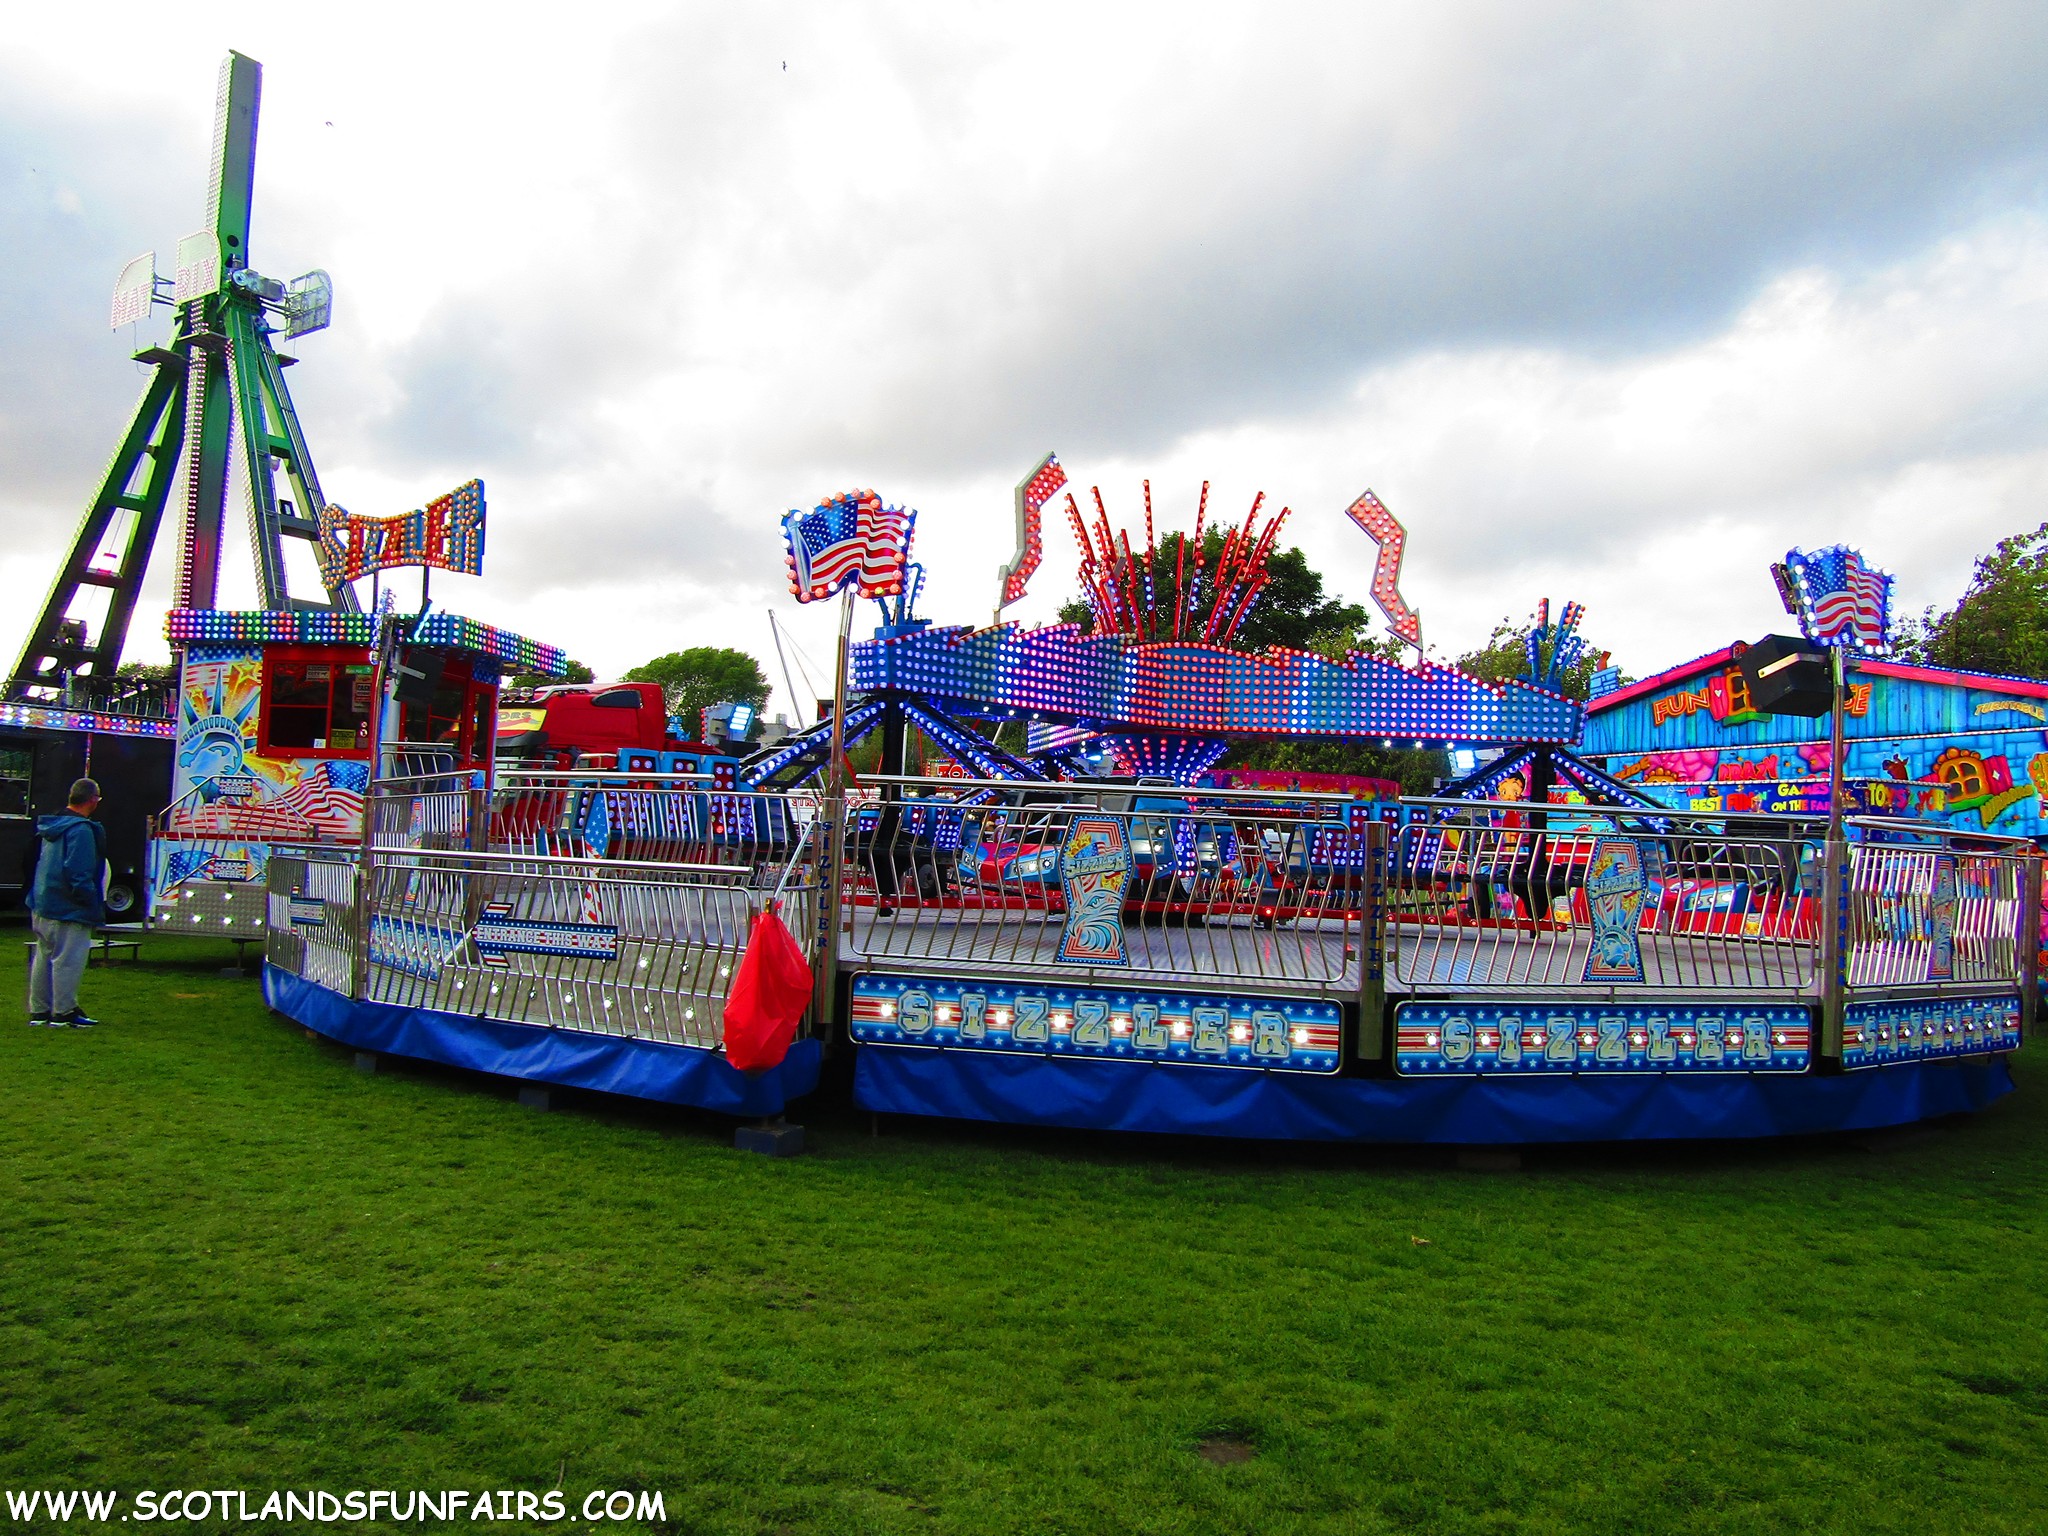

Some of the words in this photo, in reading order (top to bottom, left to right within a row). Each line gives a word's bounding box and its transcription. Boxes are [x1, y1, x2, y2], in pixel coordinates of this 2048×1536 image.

[321, 479, 484, 590] SIZZLER
[1653, 687, 1710, 726] FUN
[1974, 701, 2047, 722] TURNTABLE
[1690, 795, 1723, 812] BEST
[1771, 801, 1787, 812] ON
[1789, 799, 1809, 812] THE
[1777, 783, 1830, 797] GAMES
[817, 821, 833, 948] SIZZLER
[476, 927, 540, 944] ENTRANCE
[545, 931, 573, 947] THIS
[577, 934, 613, 951] WAY
[897, 989, 1291, 1059] SIZZLER
[1440, 1017, 1772, 1063] SIZZLER
[1863, 1005, 2004, 1057] SIZZLER
